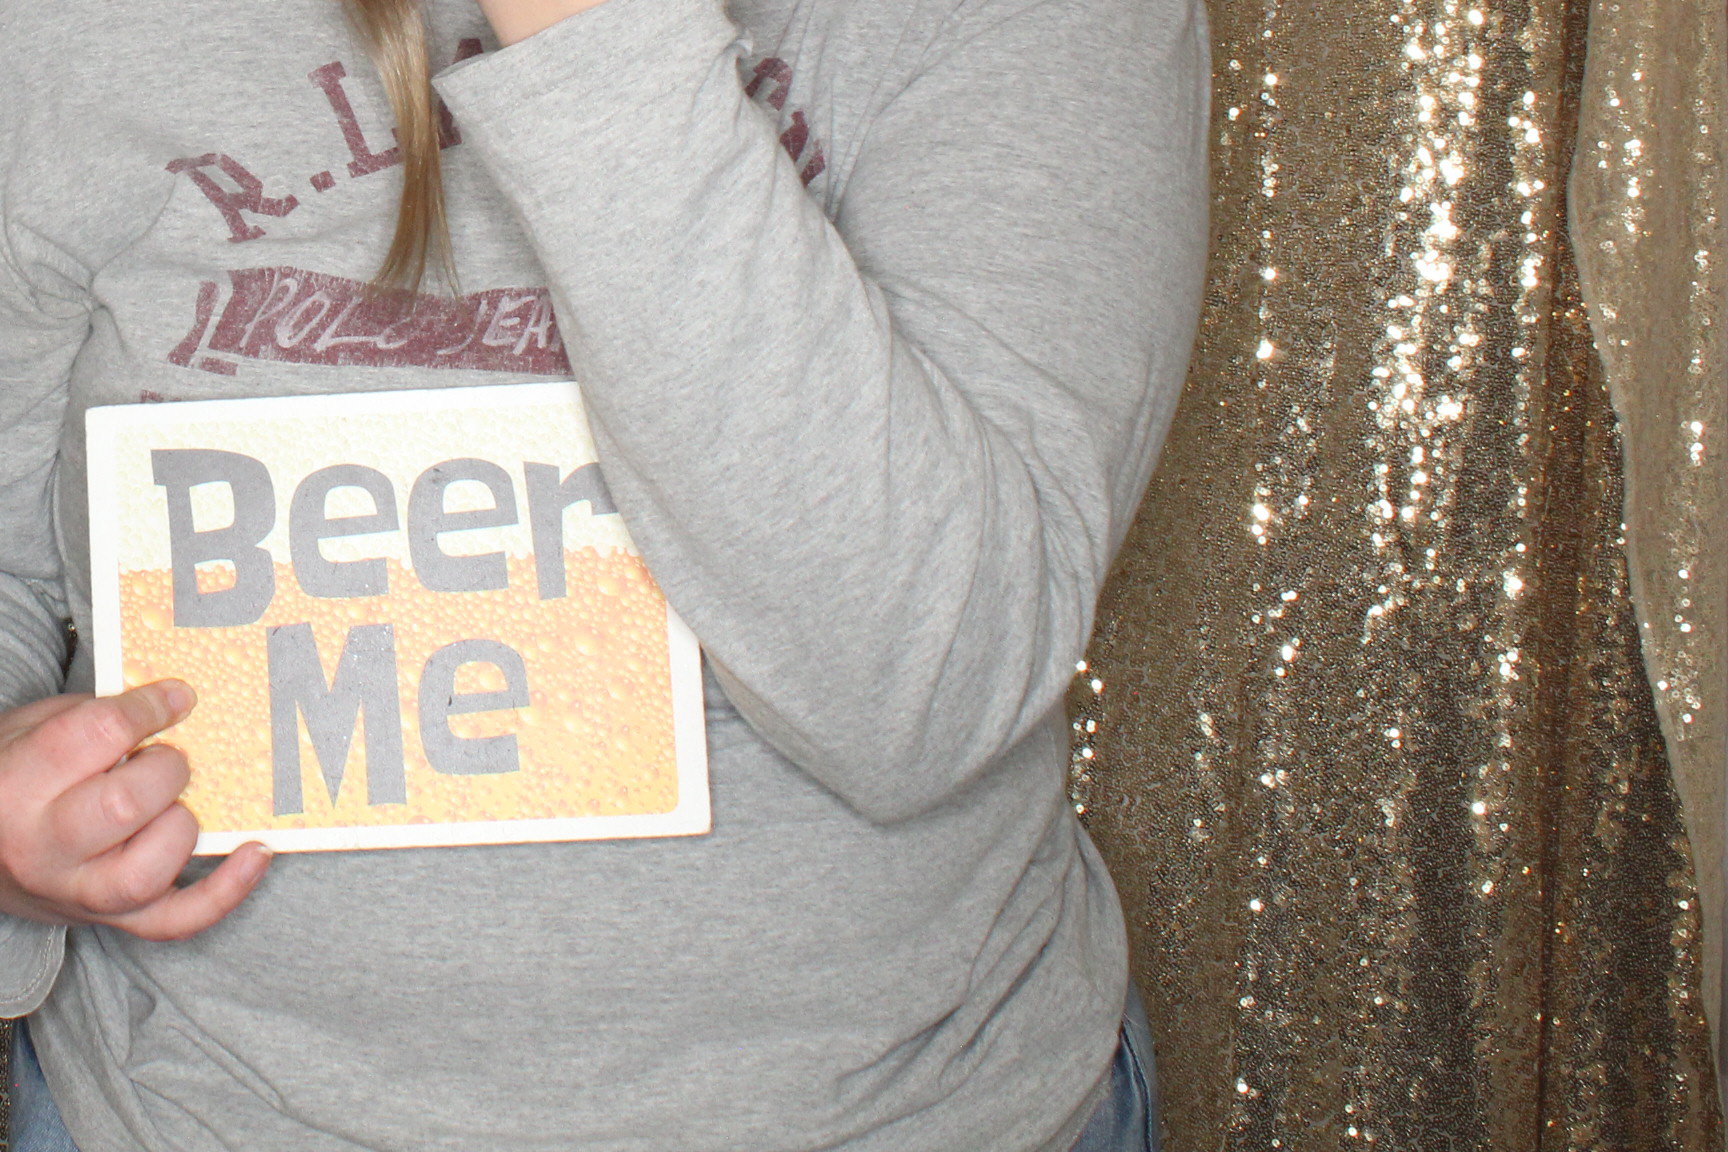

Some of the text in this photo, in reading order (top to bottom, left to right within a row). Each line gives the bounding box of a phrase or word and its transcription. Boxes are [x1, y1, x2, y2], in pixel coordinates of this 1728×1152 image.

[436, 296, 562, 355] JEA
[150, 448, 620, 628] Beer
[265, 622, 530, 817] Me
